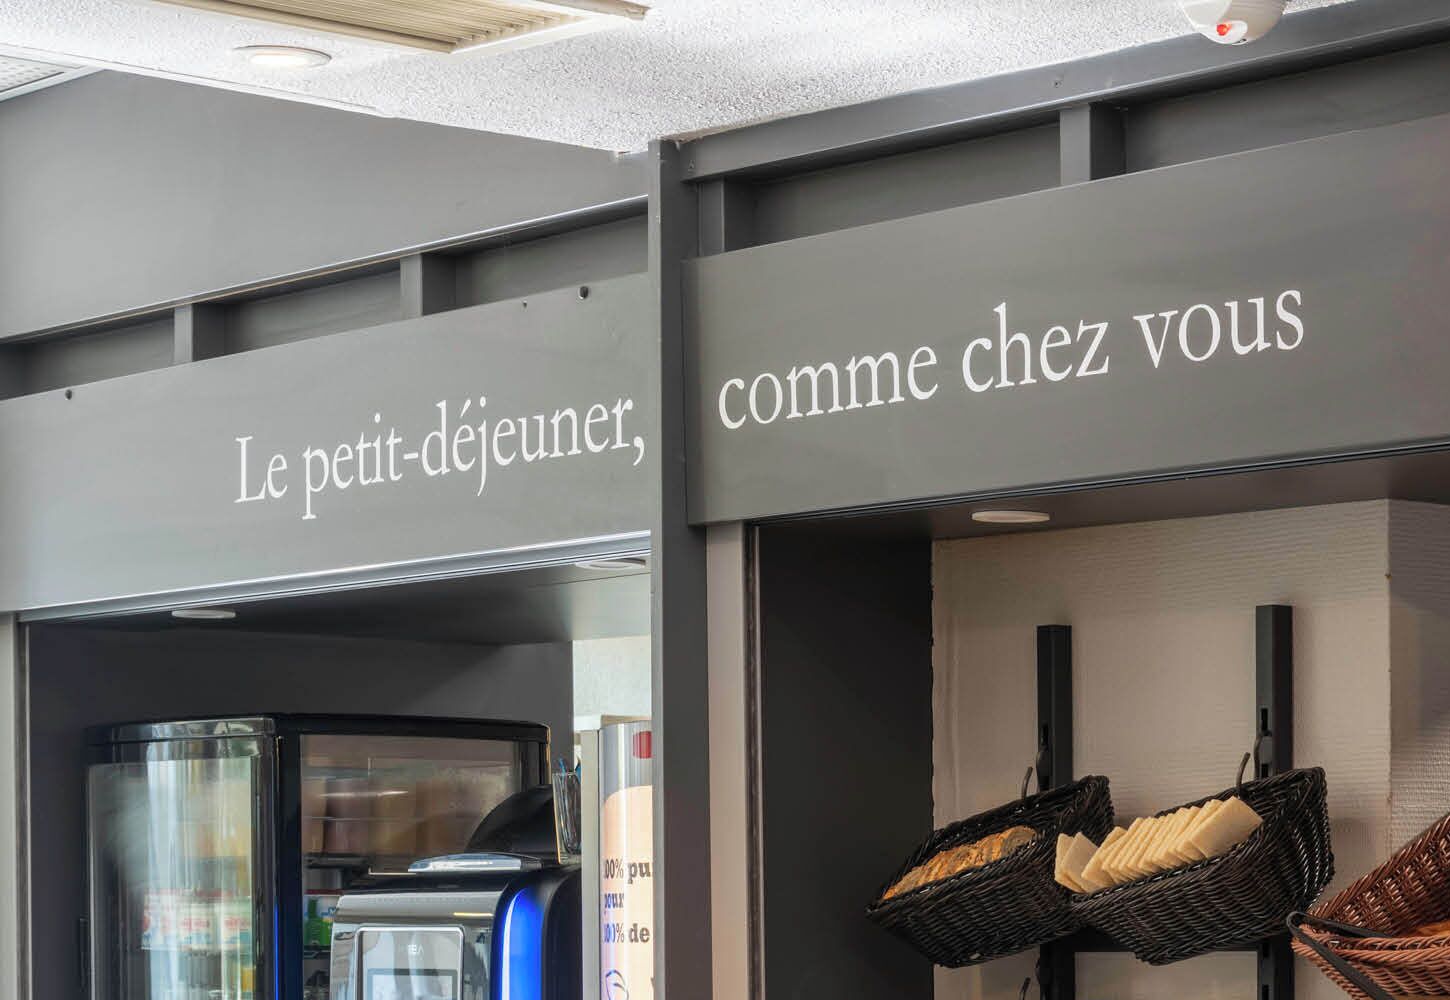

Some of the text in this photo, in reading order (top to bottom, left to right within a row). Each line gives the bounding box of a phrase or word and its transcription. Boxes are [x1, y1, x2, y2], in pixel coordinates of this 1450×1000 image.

[717, 289, 1305, 430] comme chez vous
[233, 396, 646, 521] Le petit-déjeuner,
[629, 922, 650, 943] de
